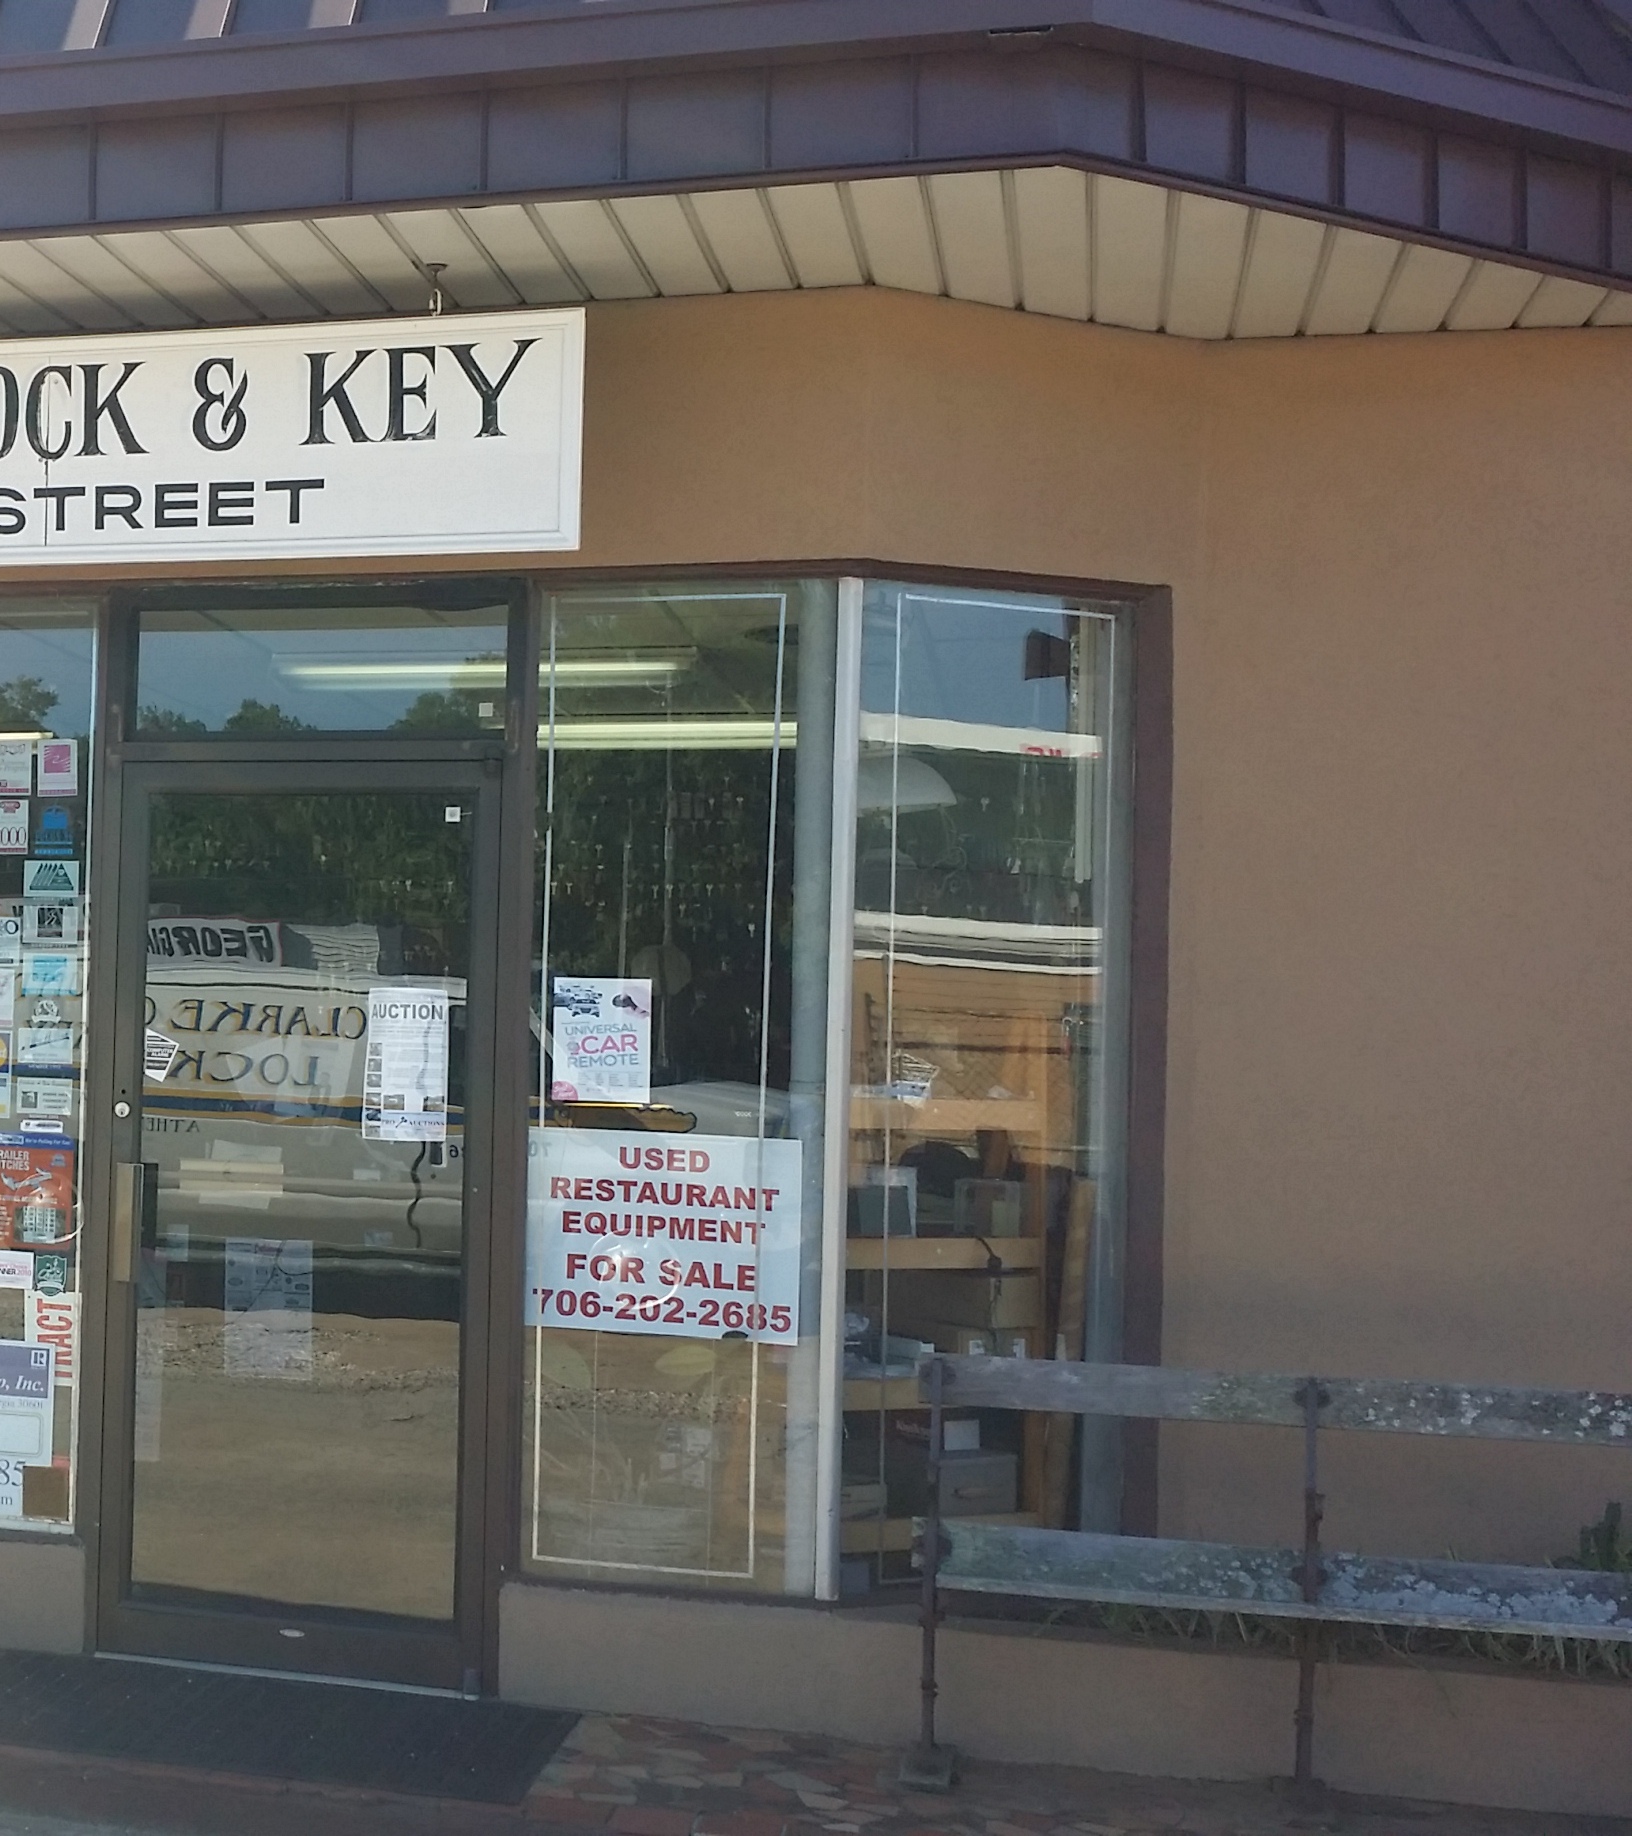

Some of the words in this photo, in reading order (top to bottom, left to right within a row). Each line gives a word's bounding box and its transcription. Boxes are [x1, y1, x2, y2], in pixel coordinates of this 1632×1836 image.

[192, 357, 248, 452] &
[299, 338, 543, 446] KEY
[371, 1003, 443, 1020] AUCTION
[565, 1023, 638, 1036] UNIVERSAL
[580, 1033, 639, 1054] CAR
[567, 1053, 639, 1068] REMOTE
[619, 1146, 710, 1173] USED
[550, 1177, 780, 1212] RESTAURANT
[562, 1211, 766, 1246] EQUIPMENT
[566, 1253, 645, 1284] FOR
[658, 1259, 757, 1292] SALE
[532, 1288, 792, 1333] 706-202-2685
[15, 1375, 45, 1393] Inc.
